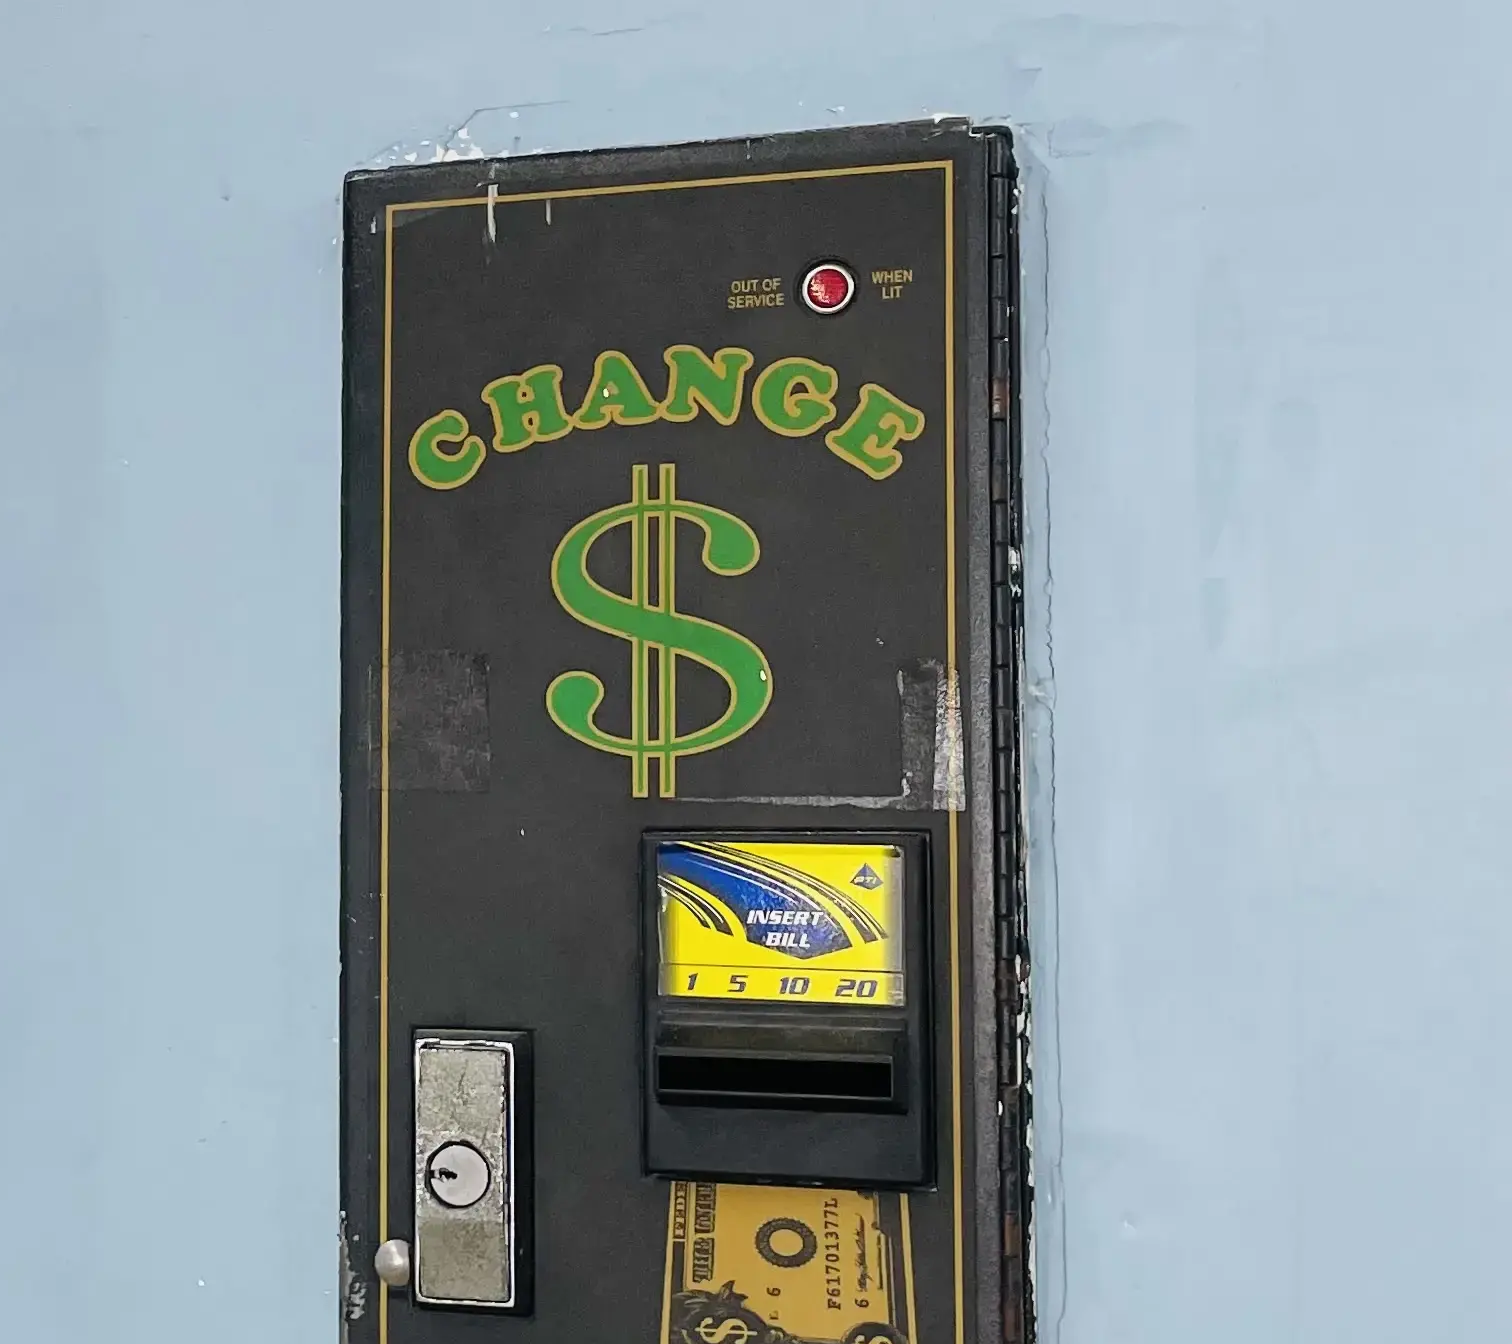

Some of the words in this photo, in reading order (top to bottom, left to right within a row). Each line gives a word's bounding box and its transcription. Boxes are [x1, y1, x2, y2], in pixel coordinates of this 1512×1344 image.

[731, 279, 759, 293] OUT
[762, 278, 782, 291] OF
[871, 269, 913, 284] WHEN
[882, 285, 903, 299] LIT
[727, 294, 784, 309] SERVICE
[408, 344, 925, 490] CHANGE
[746, 909, 825, 927] INSERT
[765, 931, 811, 949] BILL
[687, 972, 699, 991] 1
[727, 975, 749, 993] 5
[779, 976, 810, 996] 10
[835, 979, 879, 999] 20
[823, 1197, 842, 1311] F61701377L
